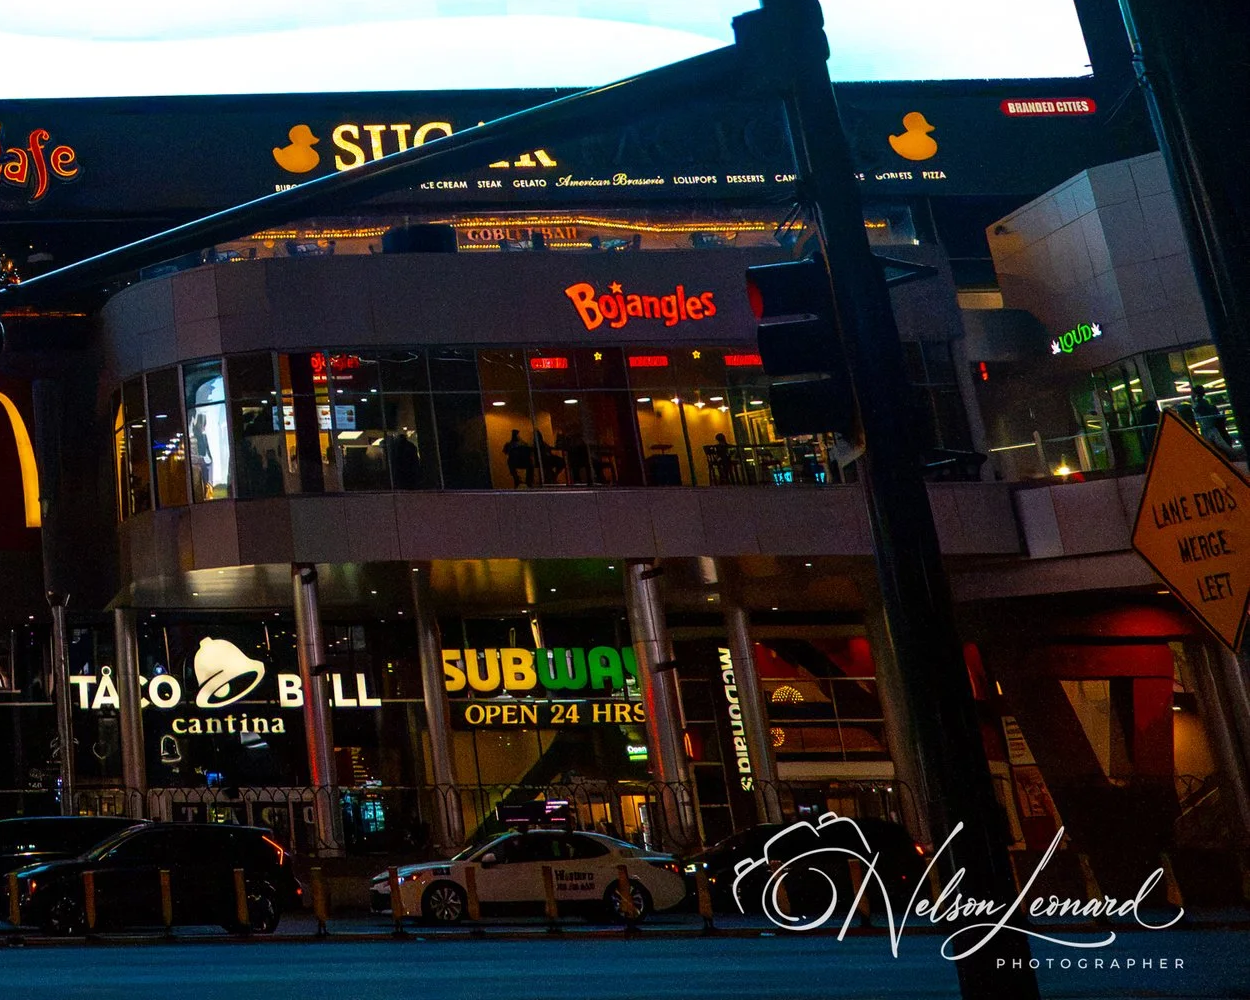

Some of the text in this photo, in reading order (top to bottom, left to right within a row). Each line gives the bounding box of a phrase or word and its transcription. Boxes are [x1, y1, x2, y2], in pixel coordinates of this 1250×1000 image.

[1007, 101, 1089, 114] BRANDED CITIES
[436, 180, 468, 189] CREAM
[477, 179, 502, 188] STEAK
[512, 178, 547, 188] GELATO
[555, 174, 610, 188] American
[612, 172, 665, 186] Brasserie
[673, 175, 718, 184] LOLLIPOPS
[726, 174, 765, 184] DESSERTS
[922, 170, 947, 180] PIZZA
[564, 281, 717, 331] Bojangles
[1058, 323, 1092, 353] LOUD
[1152, 485, 1237, 529] LANE ENDS
[1177, 530, 1232, 563] MERGE
[1197, 572, 1233, 602] LEFT
[278, 674, 382, 708] BLL
[172, 713, 286, 734] cantina
[465, 703, 646, 725] OPEN 24 HRS
[627, 745, 647, 755] Open
